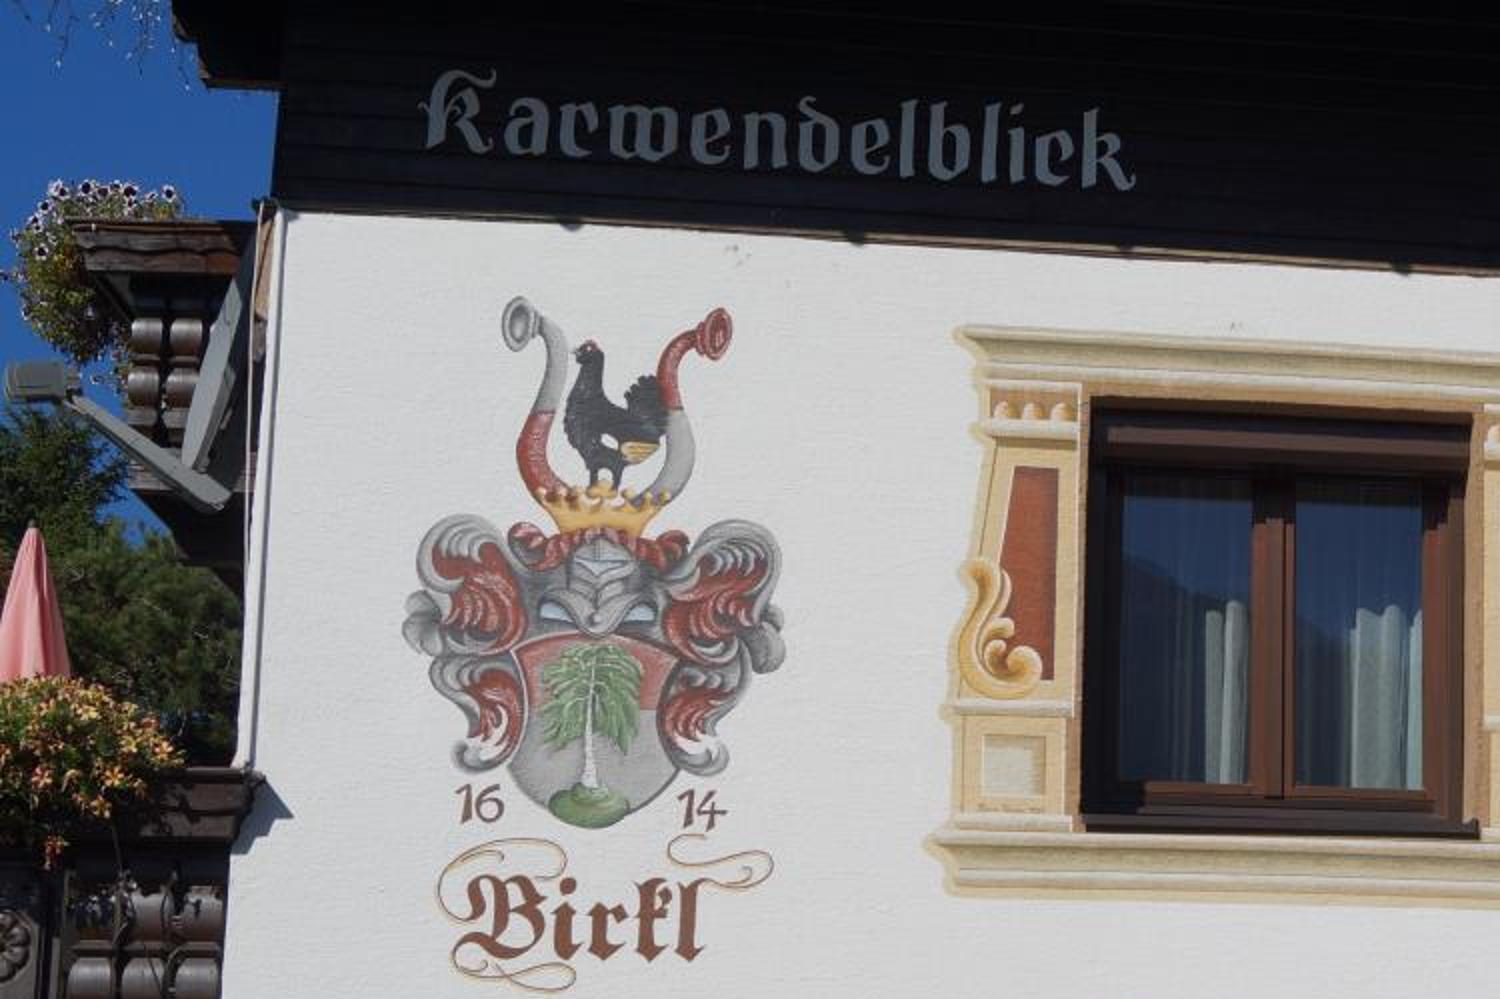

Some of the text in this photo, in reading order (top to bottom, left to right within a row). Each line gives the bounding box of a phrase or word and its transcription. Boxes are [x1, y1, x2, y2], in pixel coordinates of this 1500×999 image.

[419, 69, 1136, 191] Karwendelblick
[455, 783, 728, 832] 16 14
[452, 866, 714, 969] Birkl
